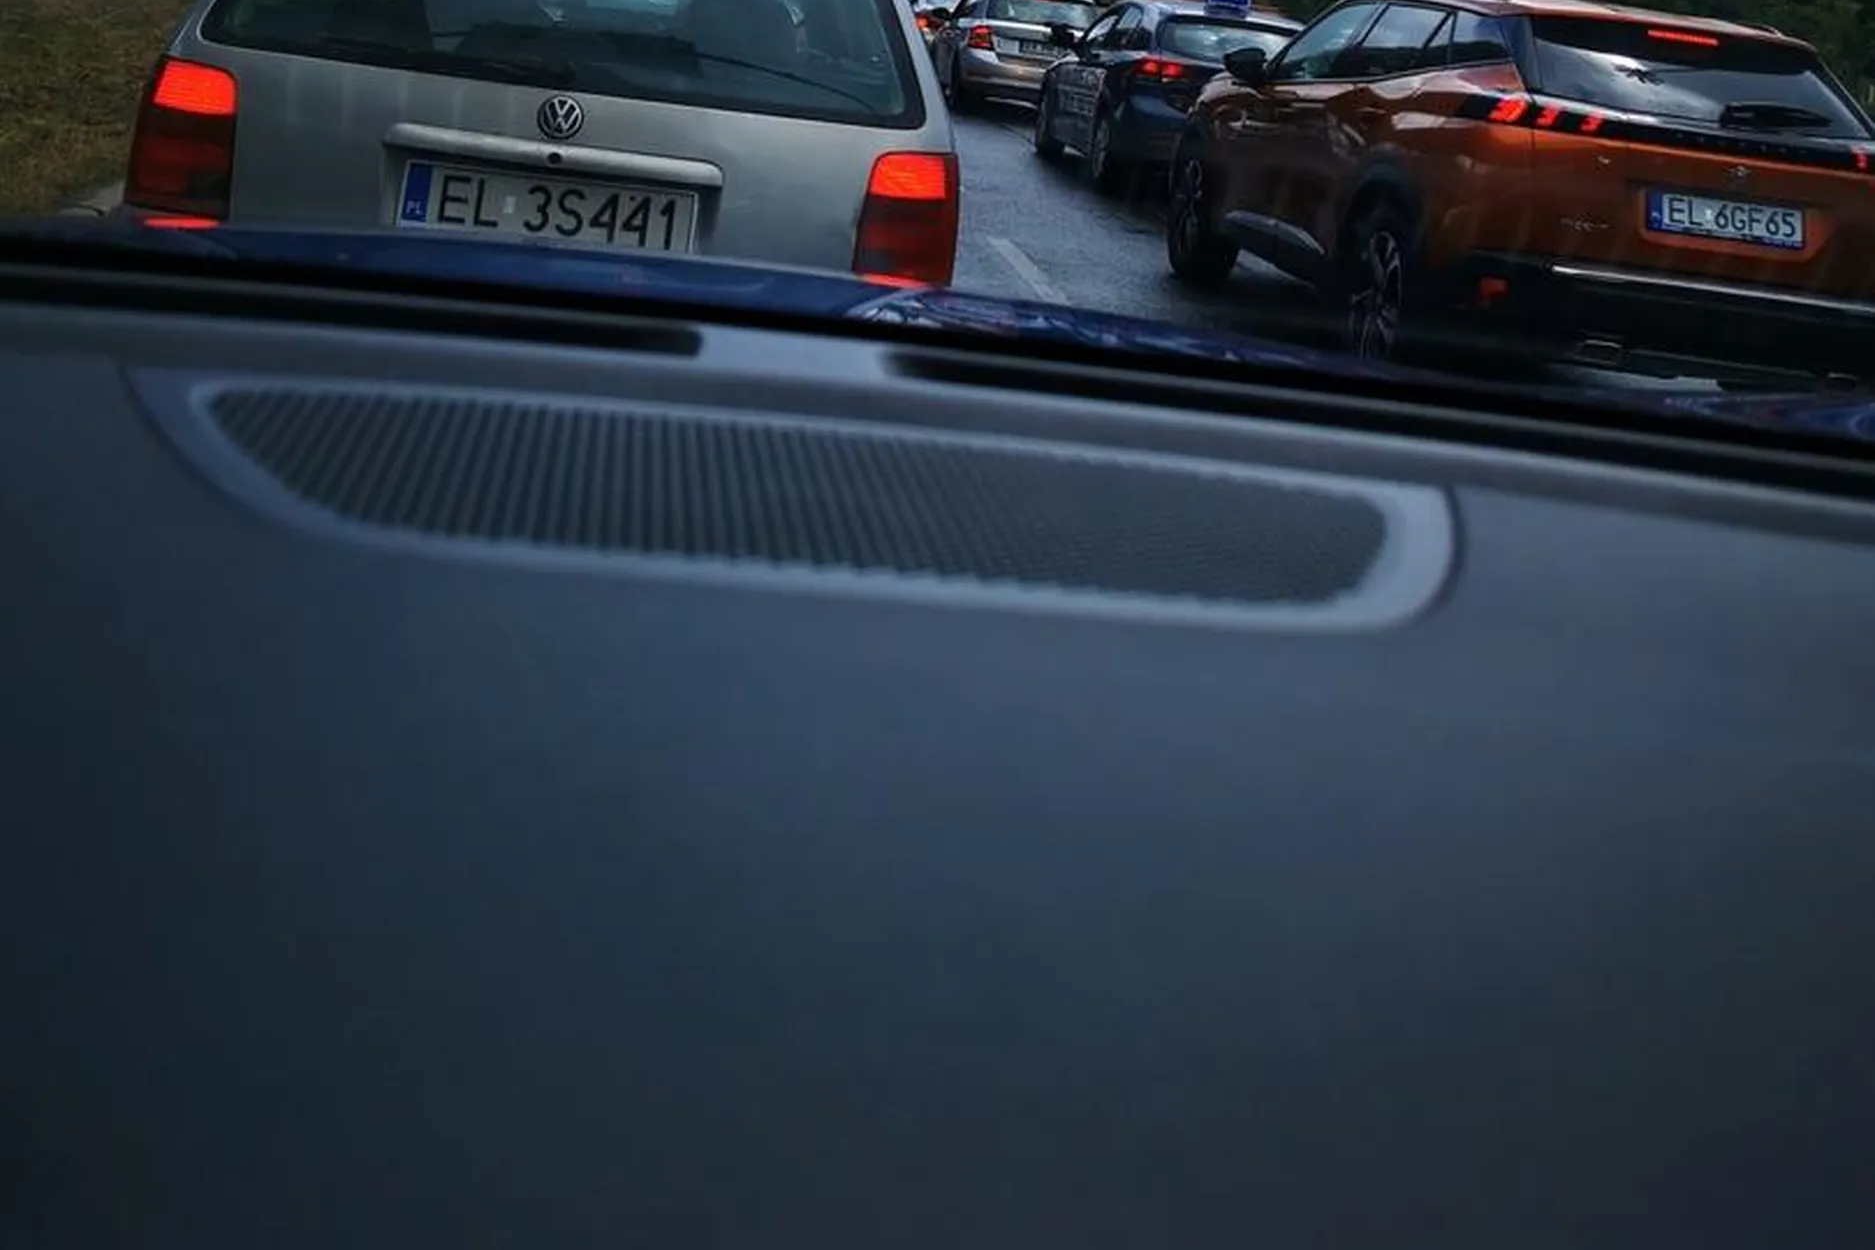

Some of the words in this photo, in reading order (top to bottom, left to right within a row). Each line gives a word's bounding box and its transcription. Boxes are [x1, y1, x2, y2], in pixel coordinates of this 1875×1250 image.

[438, 176, 498, 227] EL
[523, 185, 677, 250] 3S441
[1669, 198, 1703, 226] EL
[1715, 204, 1796, 238] 6GF65
